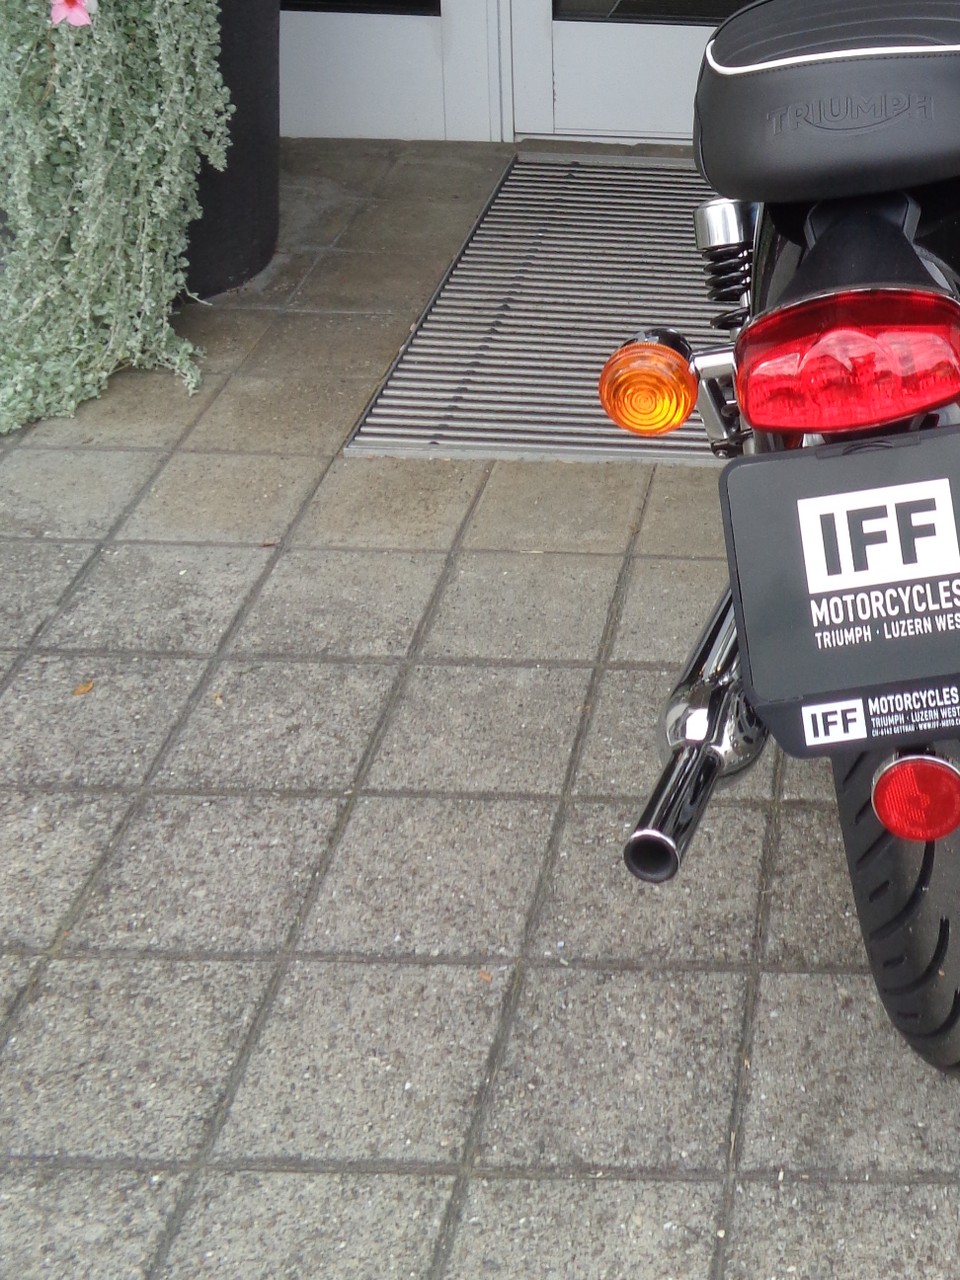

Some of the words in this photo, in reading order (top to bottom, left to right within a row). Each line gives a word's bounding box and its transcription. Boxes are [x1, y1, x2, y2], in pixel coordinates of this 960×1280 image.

[766, 93, 935, 135] TRIUMPH
[819, 497, 937, 577] IFF
[815, 625, 872, 650] TRIUMPH
[883, 616, 933, 639] LUZERN
[810, 707, 858, 739] IFF
[867, 686, 960, 716] MOTORCYCLES
[871, 714, 905, 729] TRIUMPH
[910, 710, 939, 723] LUZERN
[940, 706, 960, 719] WEST
